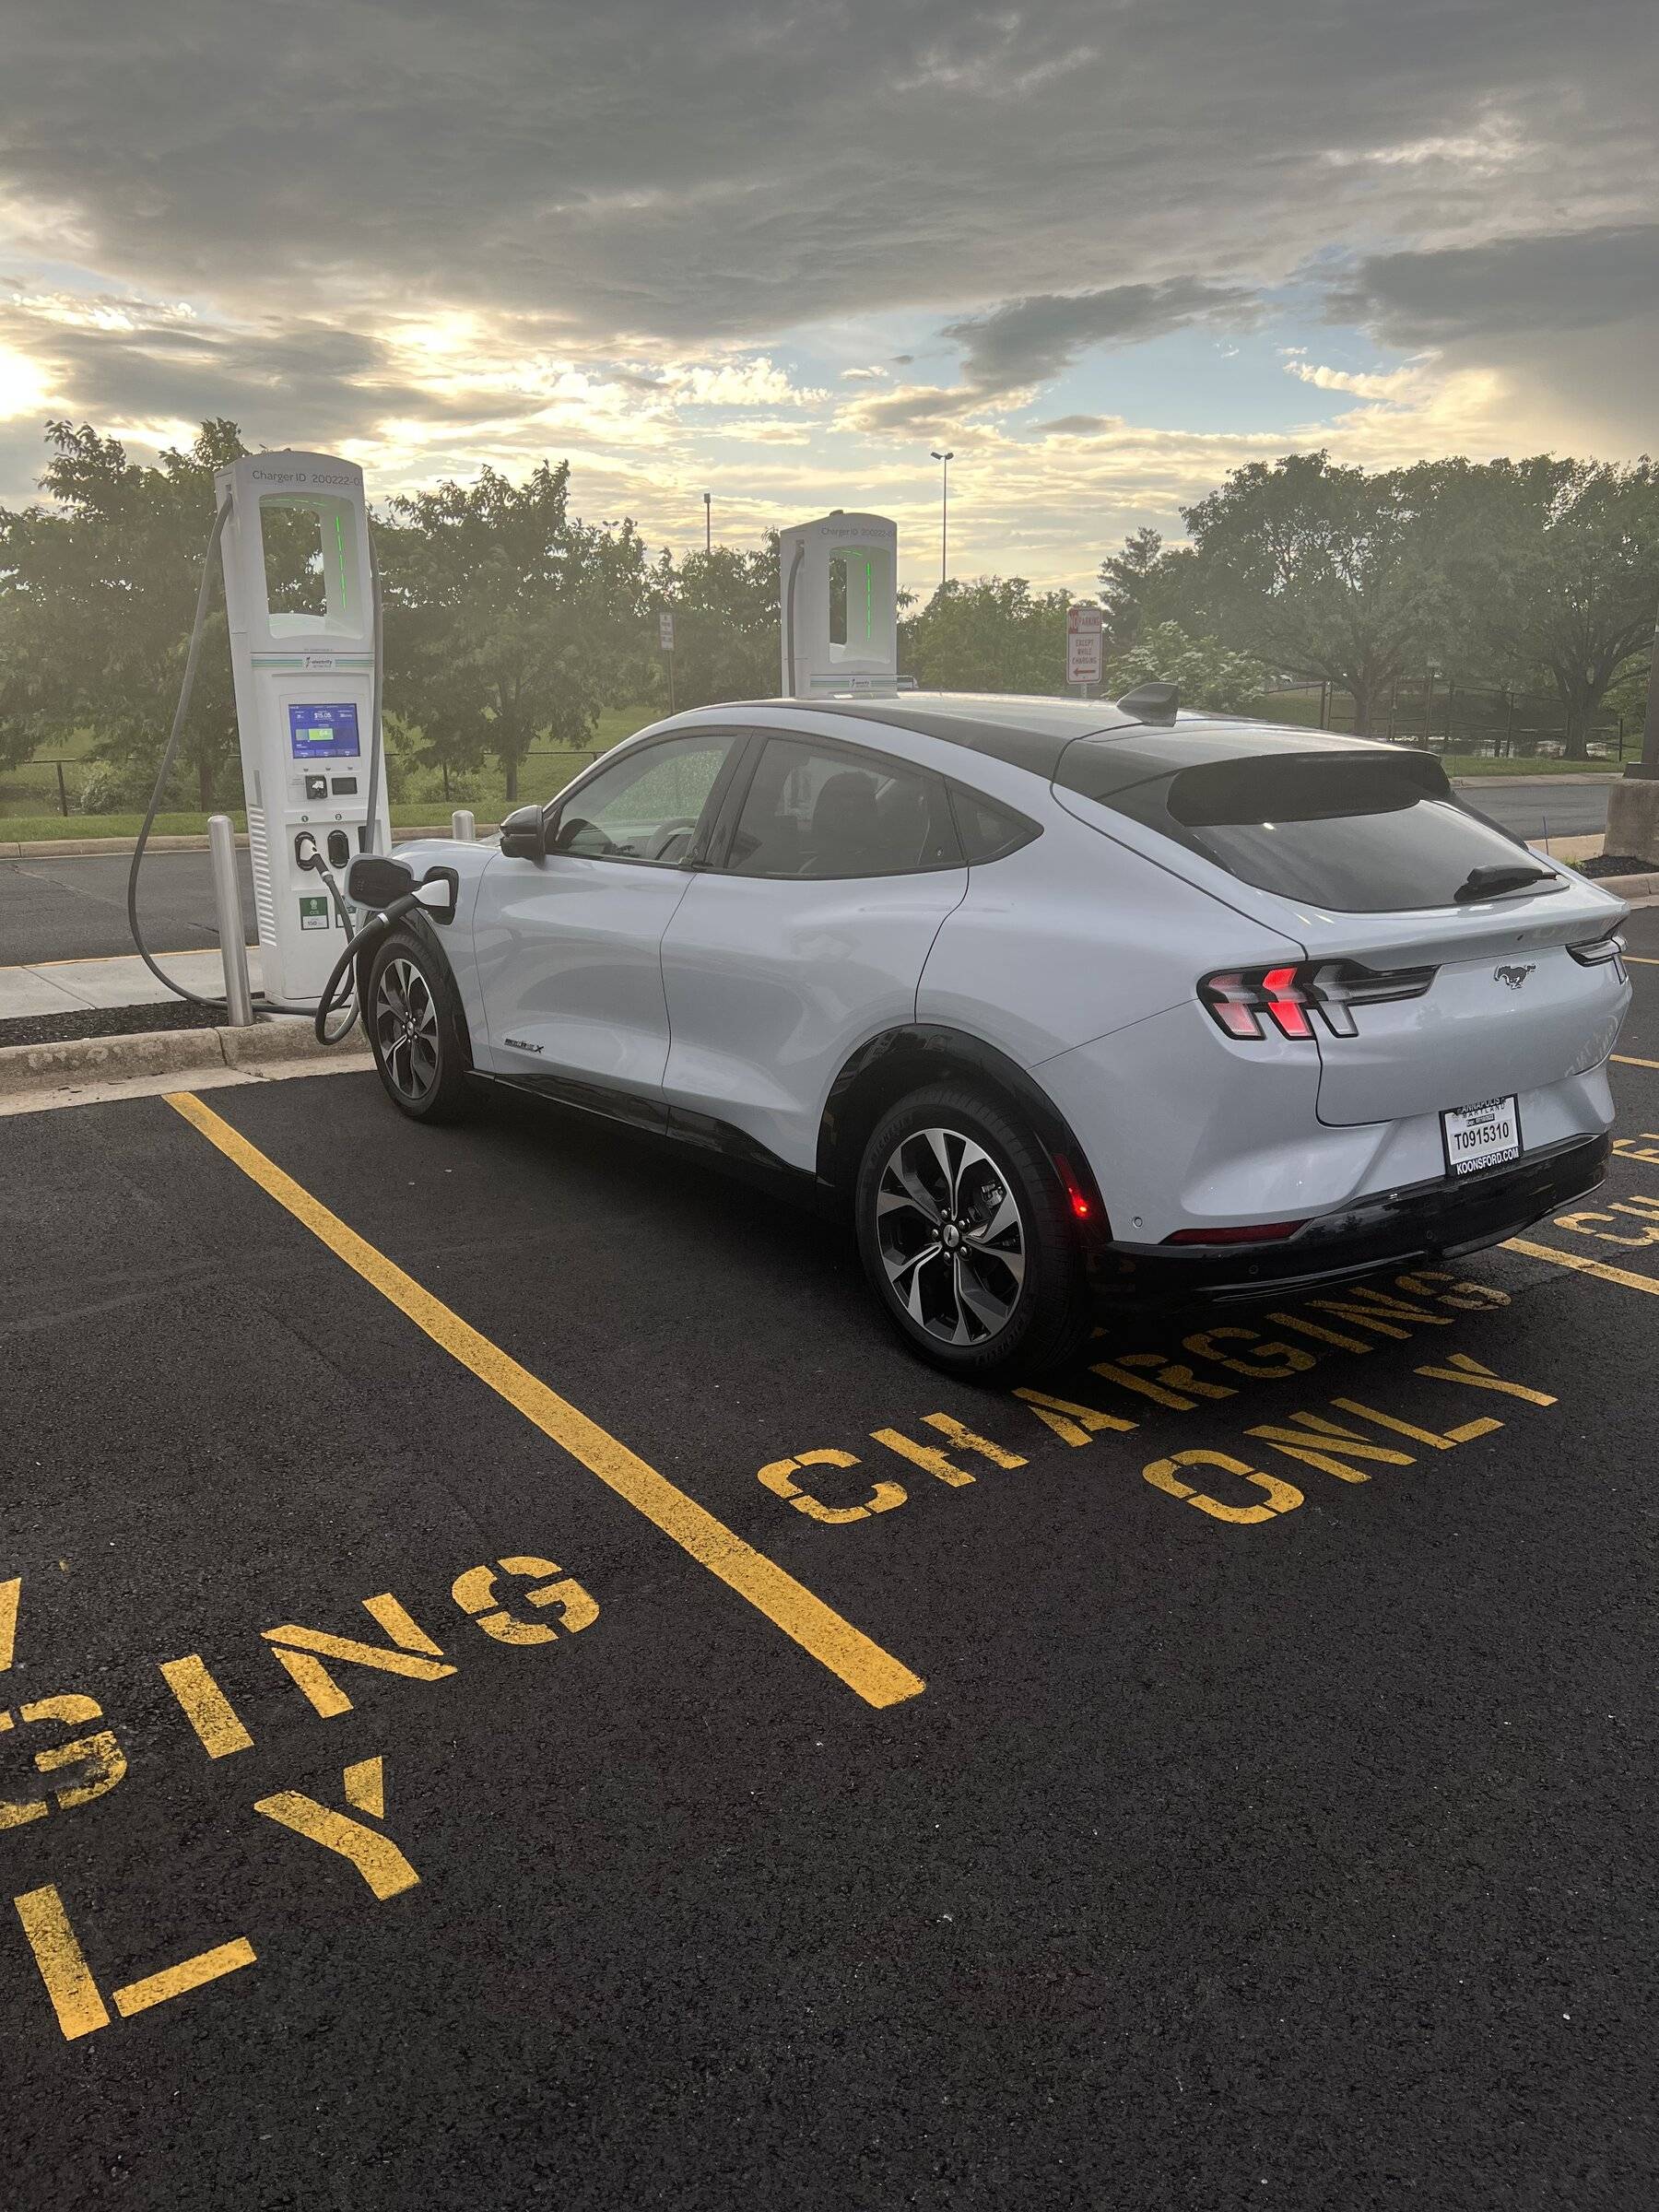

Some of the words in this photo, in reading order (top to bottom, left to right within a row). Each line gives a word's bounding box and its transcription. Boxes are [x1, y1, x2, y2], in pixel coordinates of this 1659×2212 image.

[252, 470, 294, 483] Charger
[296, 473, 306, 482] ID
[820, 526, 849, 538] Charger
[1454, 1122, 1509, 1150] T0915310
[1456, 1147, 1519, 1175] KOONSFORD.COM
[757, 1271, 1512, 1524] CHARGING
[1142, 1353, 1559, 1524] ONLY
